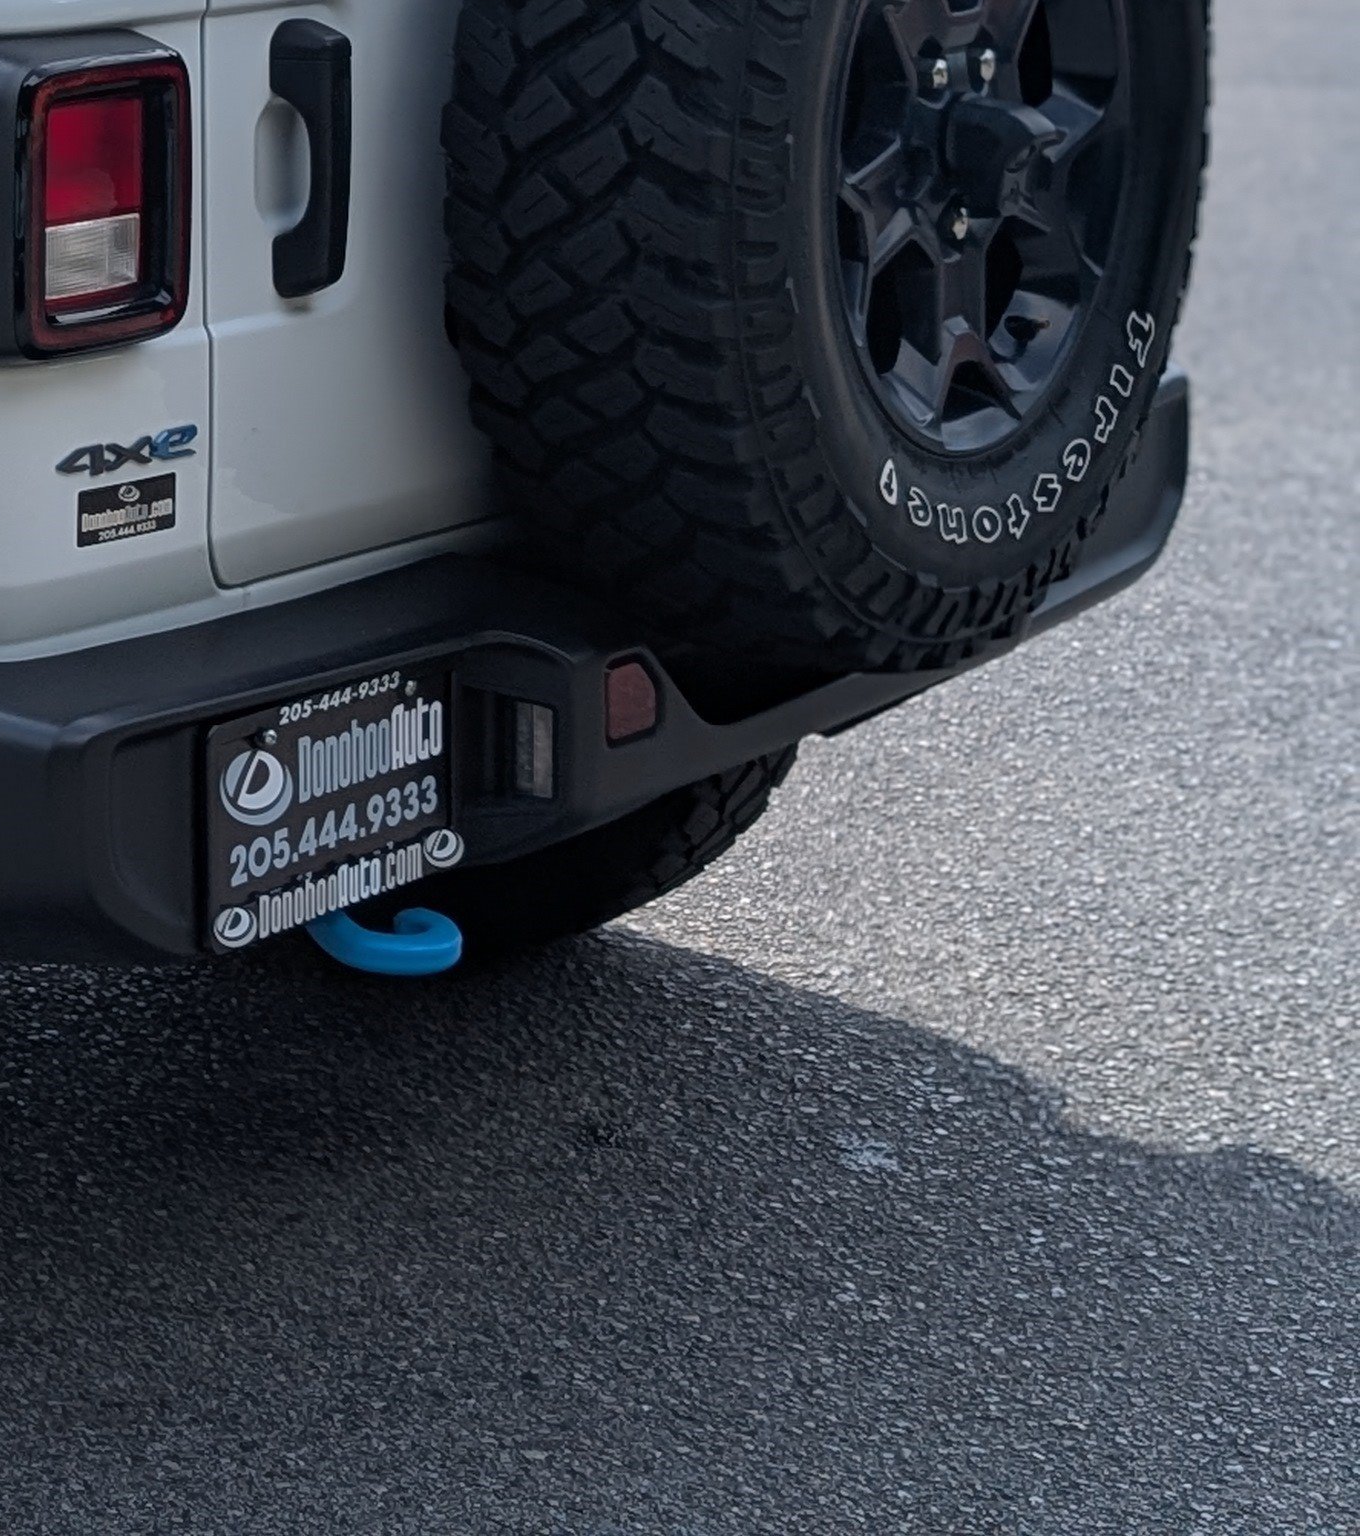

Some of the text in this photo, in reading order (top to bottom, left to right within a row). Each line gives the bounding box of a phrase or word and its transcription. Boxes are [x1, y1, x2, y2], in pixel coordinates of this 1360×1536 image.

[907, 309, 1157, 545] Firestone
[279, 670, 401, 725] 205-444-9333
[230, 775, 438, 888] 205.444.9333
[258, 842, 424, 939] DonohooAuto.com
